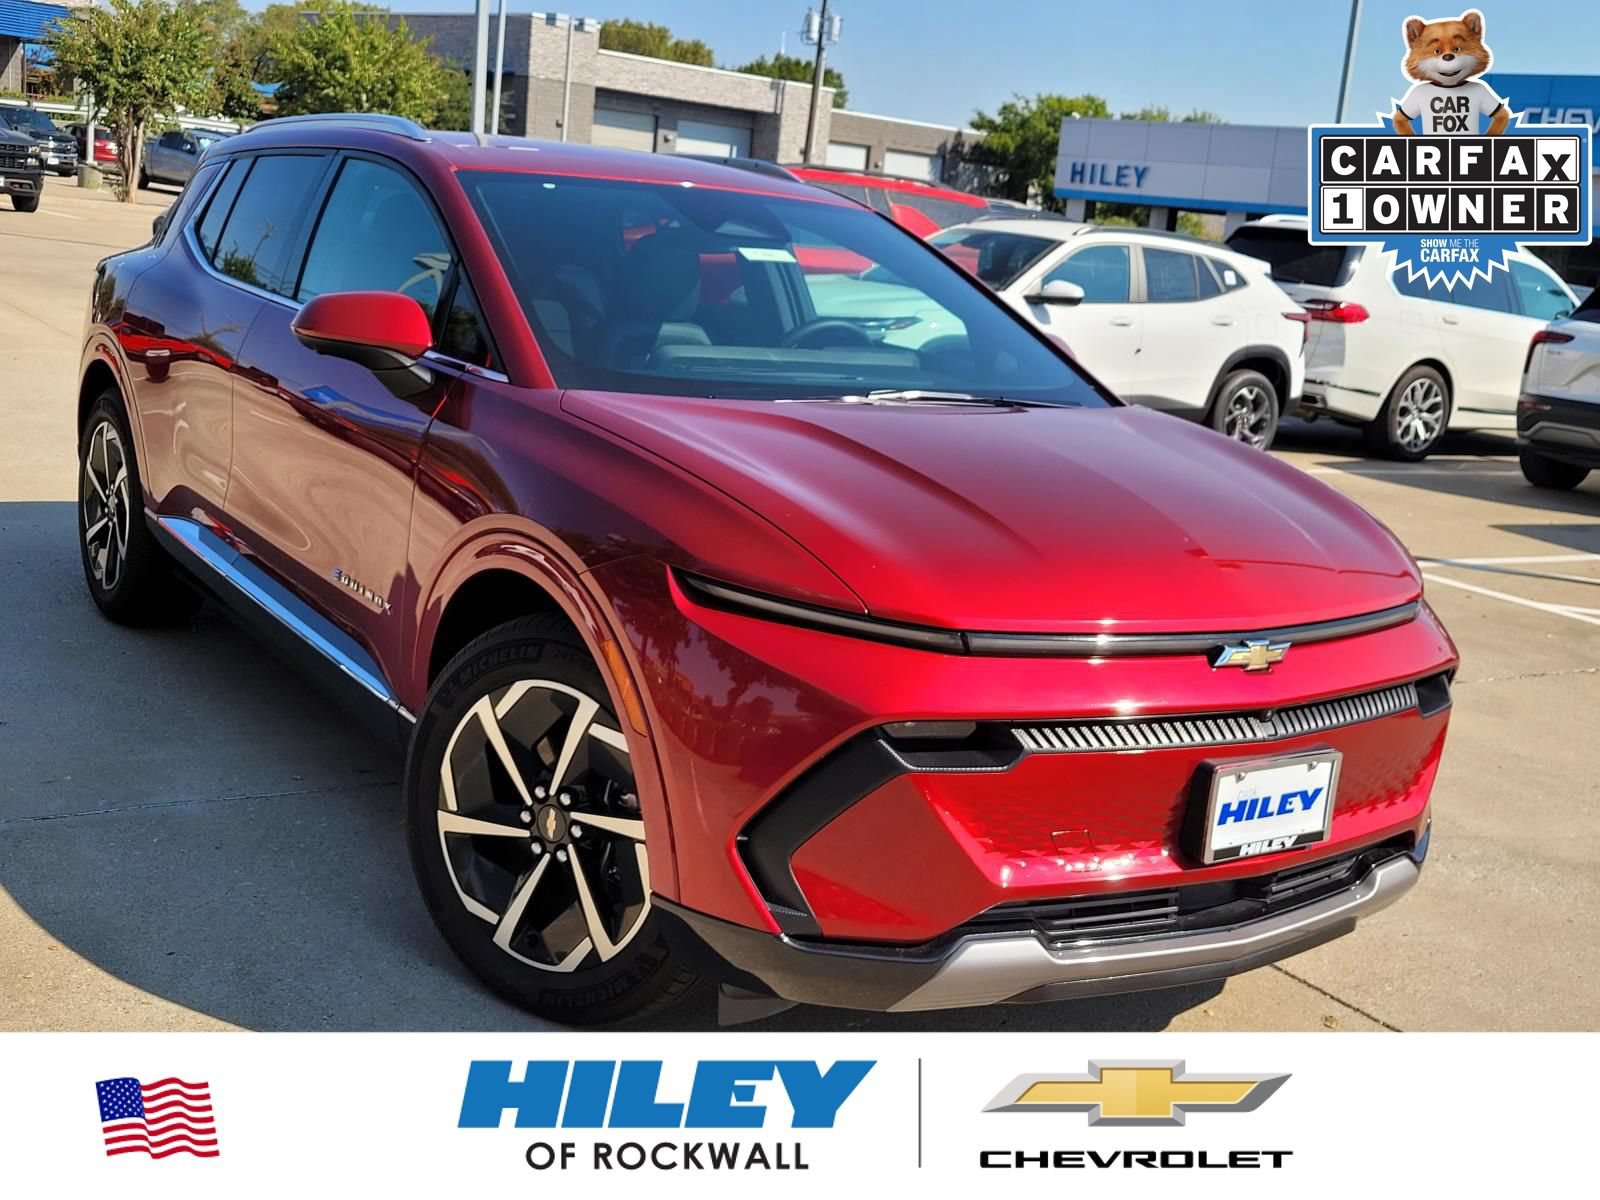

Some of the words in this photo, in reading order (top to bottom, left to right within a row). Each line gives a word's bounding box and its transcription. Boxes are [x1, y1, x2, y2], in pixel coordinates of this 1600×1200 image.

[1070, 162, 1150, 188] HILEY
[459, 642, 542, 684] MICHELIN
[1217, 787, 1324, 826] HILEY
[1239, 834, 1299, 857] HILEY
